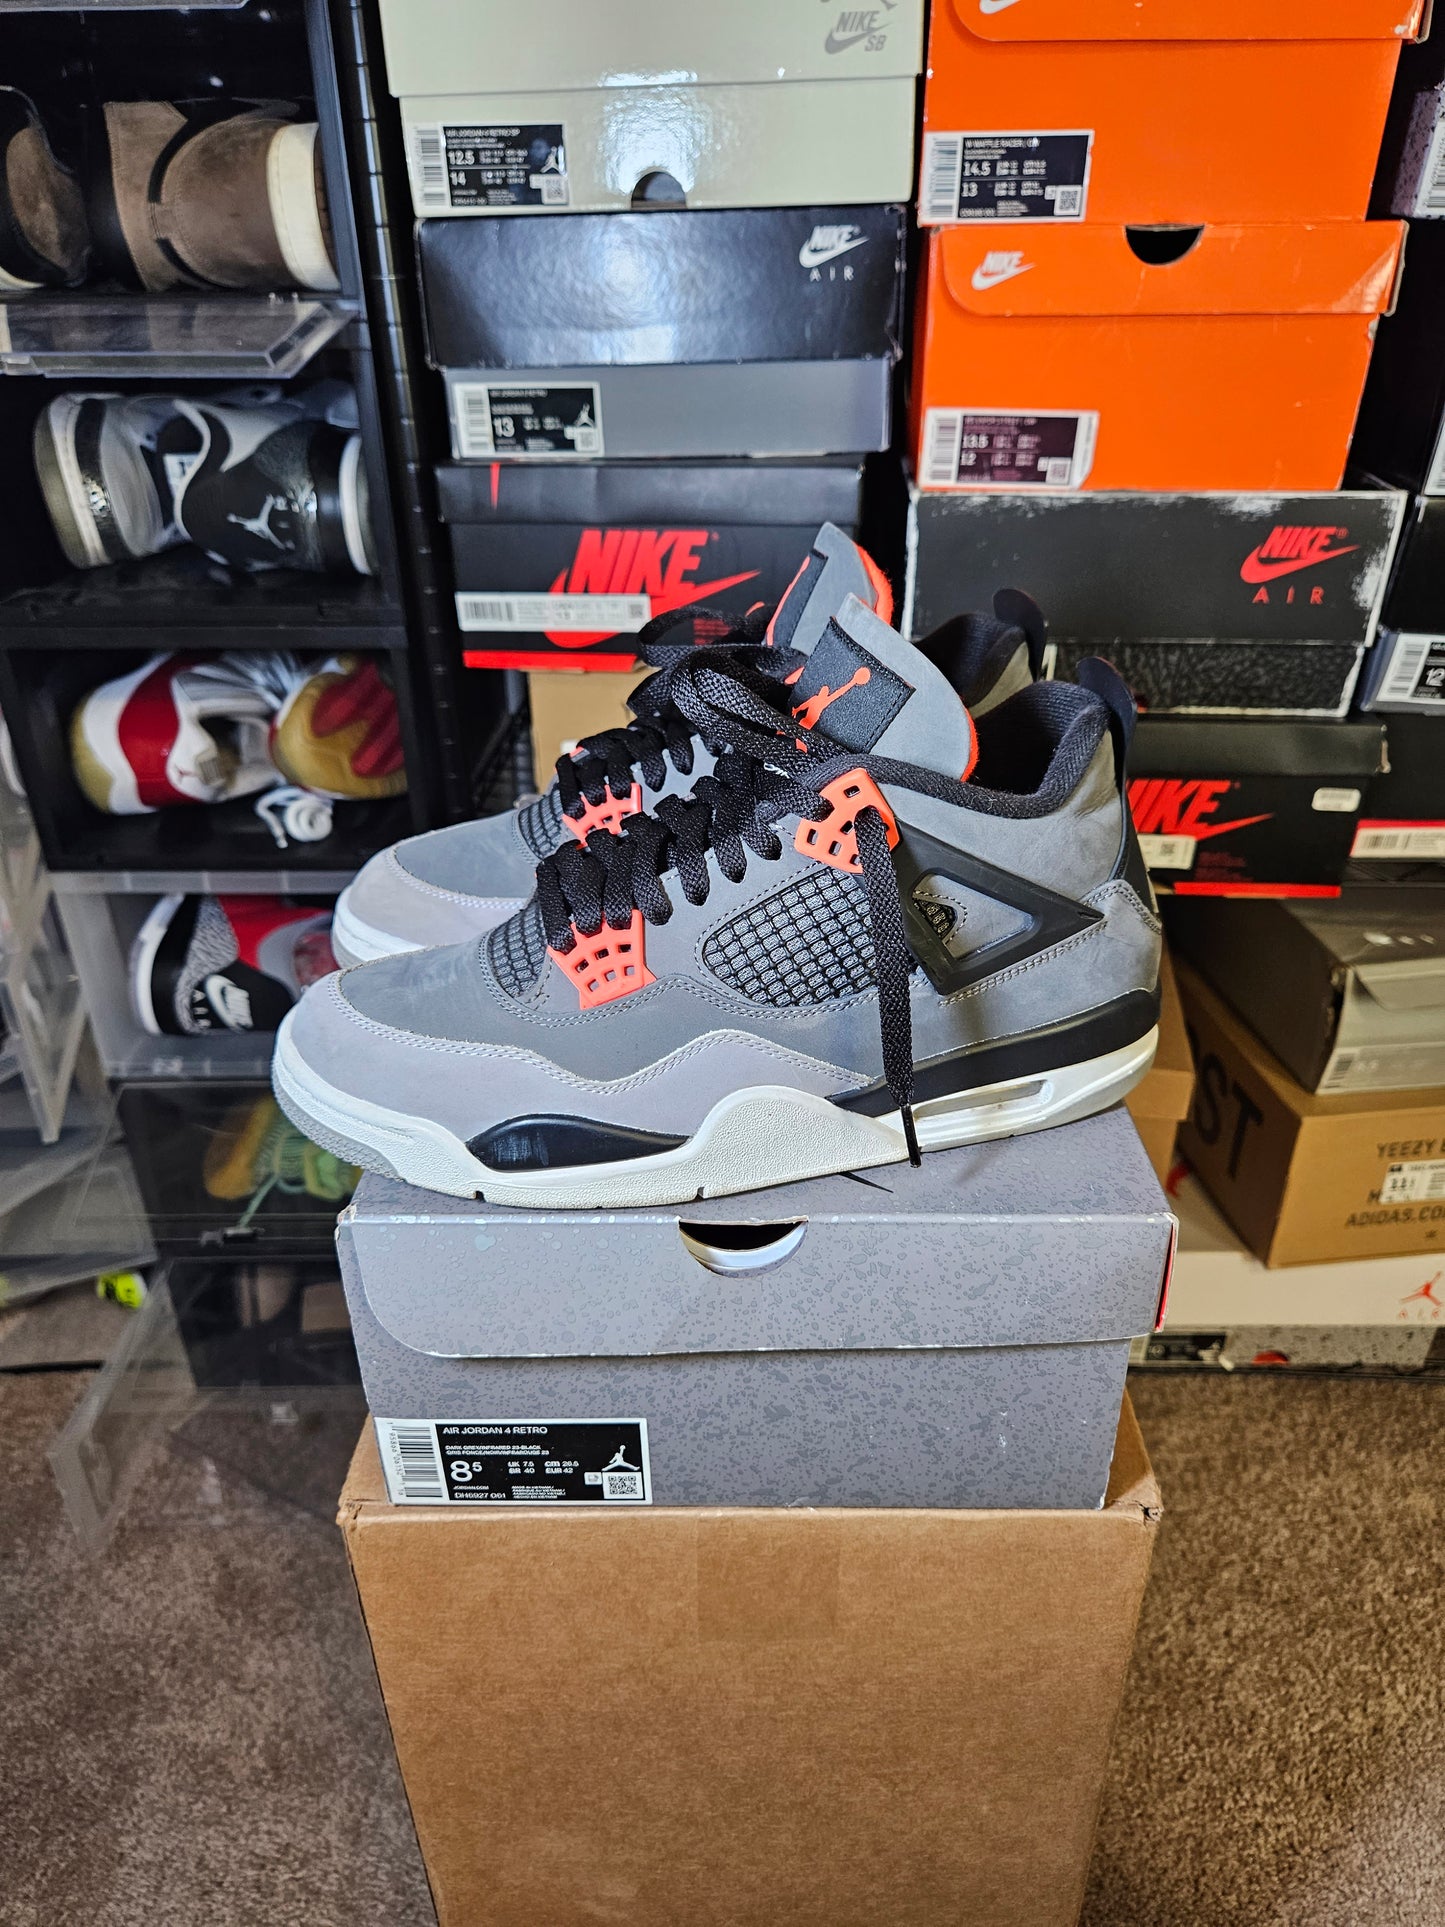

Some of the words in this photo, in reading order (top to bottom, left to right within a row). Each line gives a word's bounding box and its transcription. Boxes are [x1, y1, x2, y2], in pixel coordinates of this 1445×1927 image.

[836, 10, 880, 33] NIKE
[864, 34, 887, 52] SB
[447, 150, 475, 165] 12.5
[963, 161, 991, 176] 14.5
[450, 171, 467, 186] 14
[961, 182, 978, 197] 13
[809, 225, 852, 251] NIKE
[983, 251, 1024, 277] NIKE
[809, 265, 854, 283] AIR
[494, 416, 516, 438] 13
[1259, 525, 1337, 559] NIKE
[568, 528, 709, 598] NIKE
[1252, 585, 1325, 604] AIR
[1377, 1139, 1436, 1158] YEEZY
[461, 1427, 503, 1435] JORDAN
